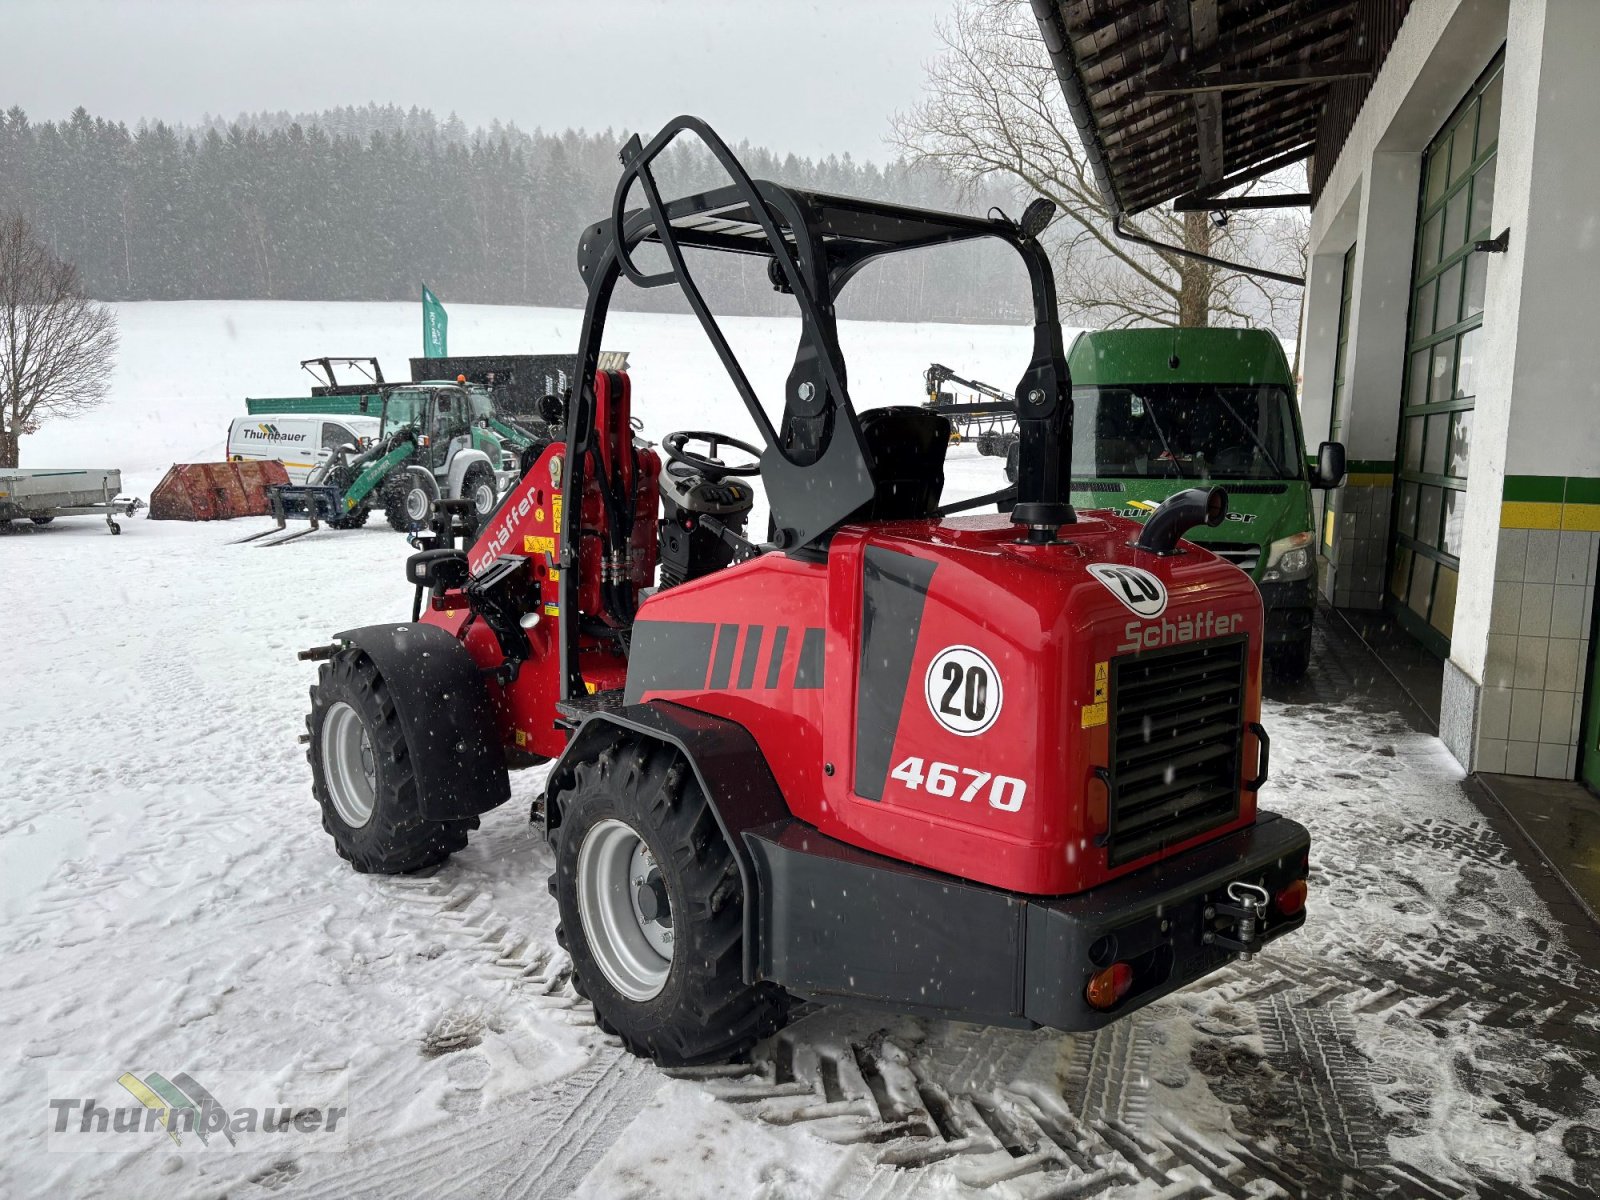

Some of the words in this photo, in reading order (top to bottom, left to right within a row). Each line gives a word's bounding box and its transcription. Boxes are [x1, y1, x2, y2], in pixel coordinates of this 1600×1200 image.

[243, 429, 307, 442] Thurnbauer
[471, 486, 536, 576] Schäffer
[1099, 567, 1160, 604] 20
[1116, 610, 1243, 652] Schäffer
[940, 661, 988, 722] 20
[891, 755, 1028, 813] 4670
